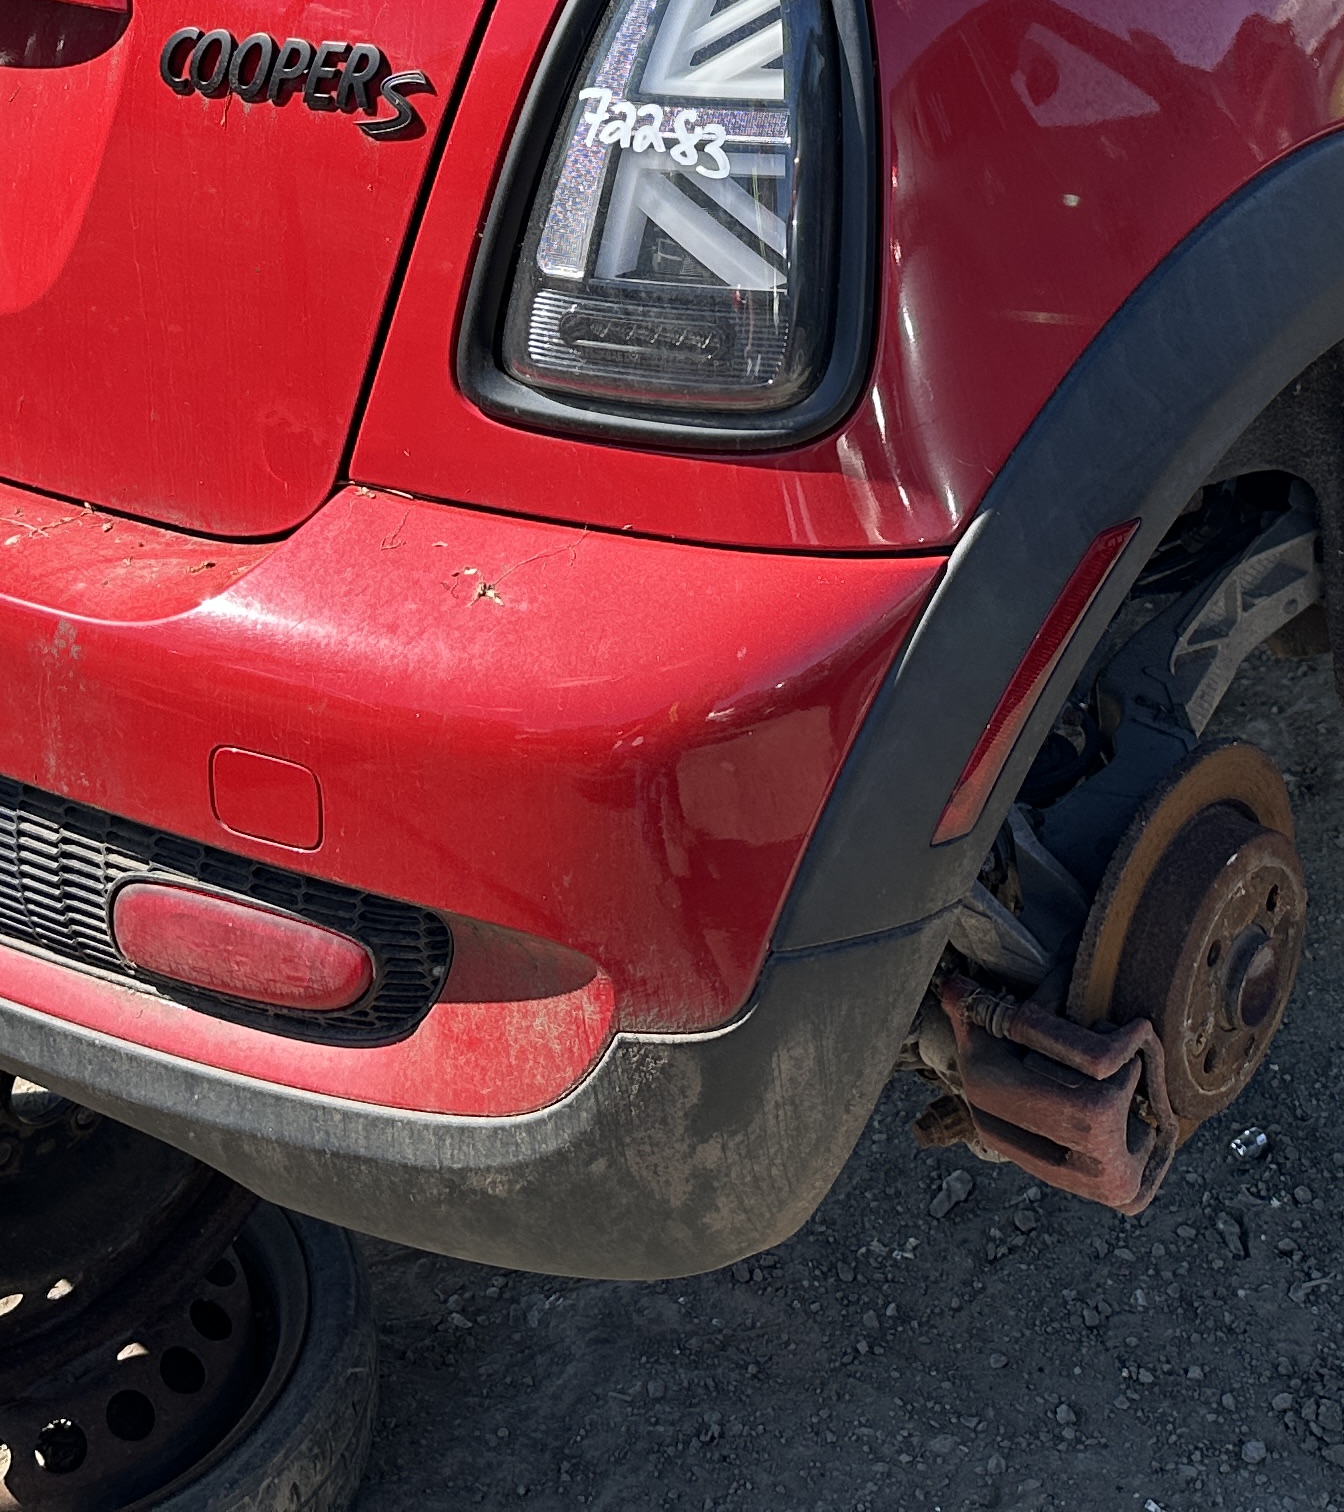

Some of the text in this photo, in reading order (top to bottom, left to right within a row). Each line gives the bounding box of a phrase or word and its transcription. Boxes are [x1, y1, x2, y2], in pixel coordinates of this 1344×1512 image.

[159, 26, 431, 140] COOPER S
[578, 87, 731, 179] 72283
